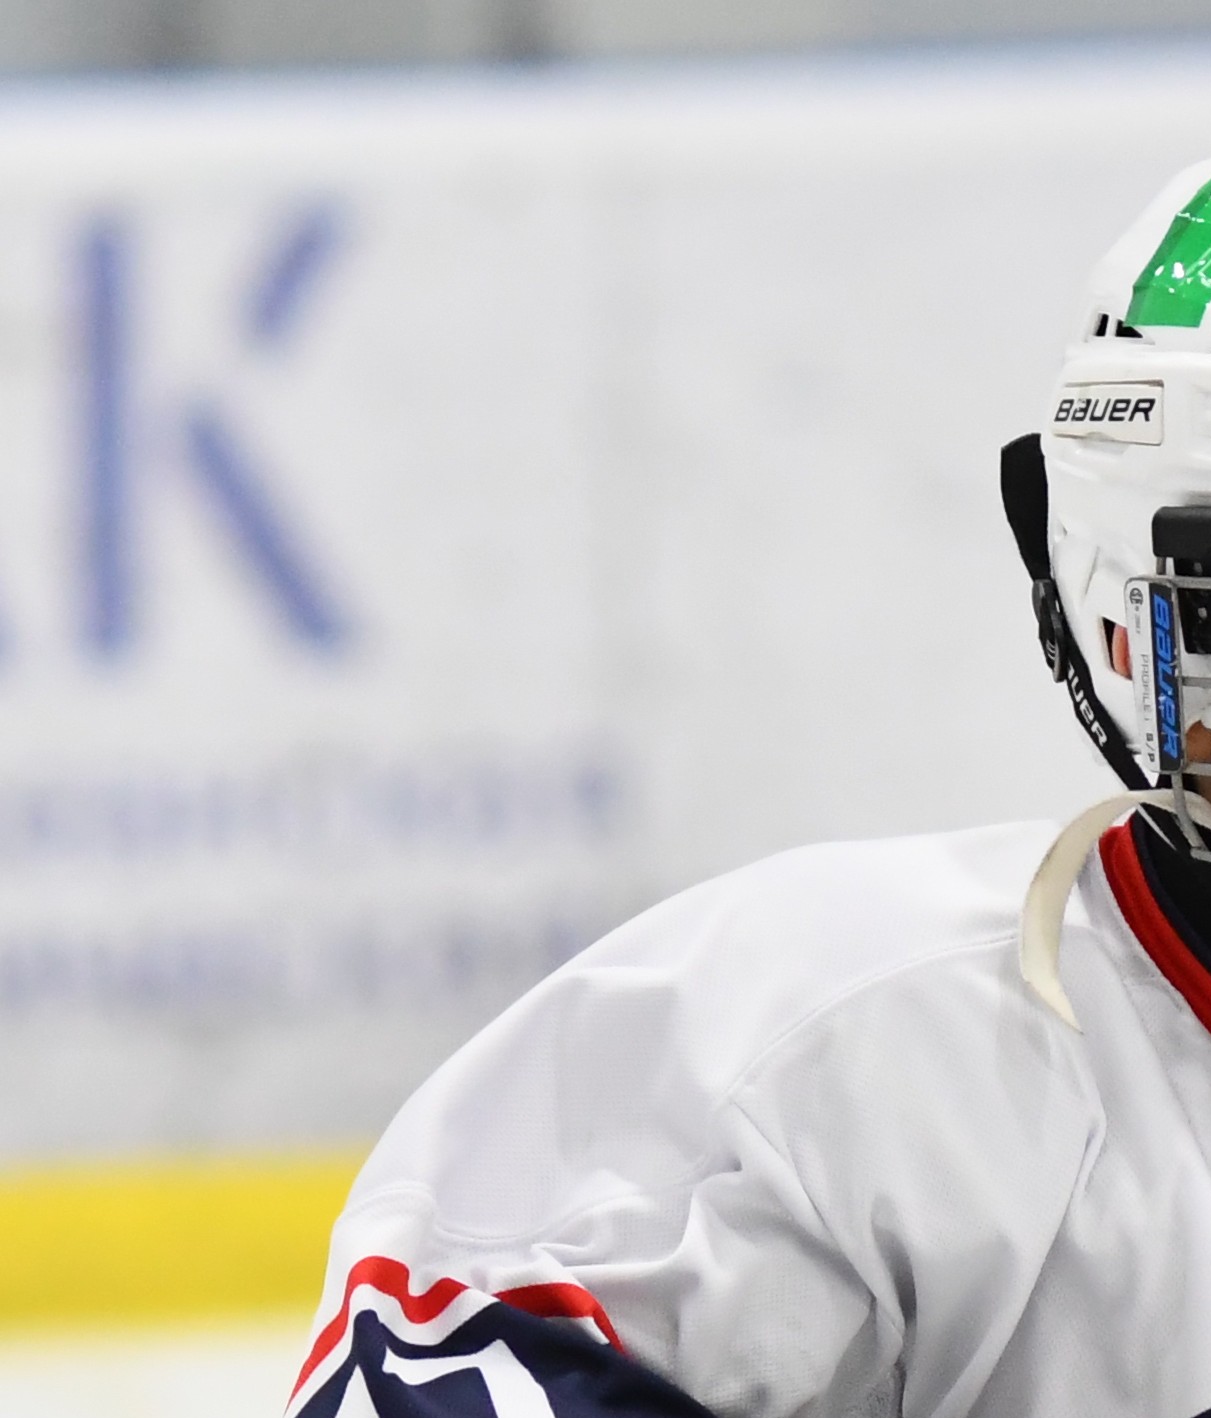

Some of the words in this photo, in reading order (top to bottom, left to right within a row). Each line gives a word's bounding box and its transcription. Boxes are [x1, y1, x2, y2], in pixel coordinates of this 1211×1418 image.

[0, 200, 354, 668] К
[1053, 398, 1156, 422] BAUER
[1067, 659, 1108, 747] UER
[1154, 594, 1178, 759] BAUER
